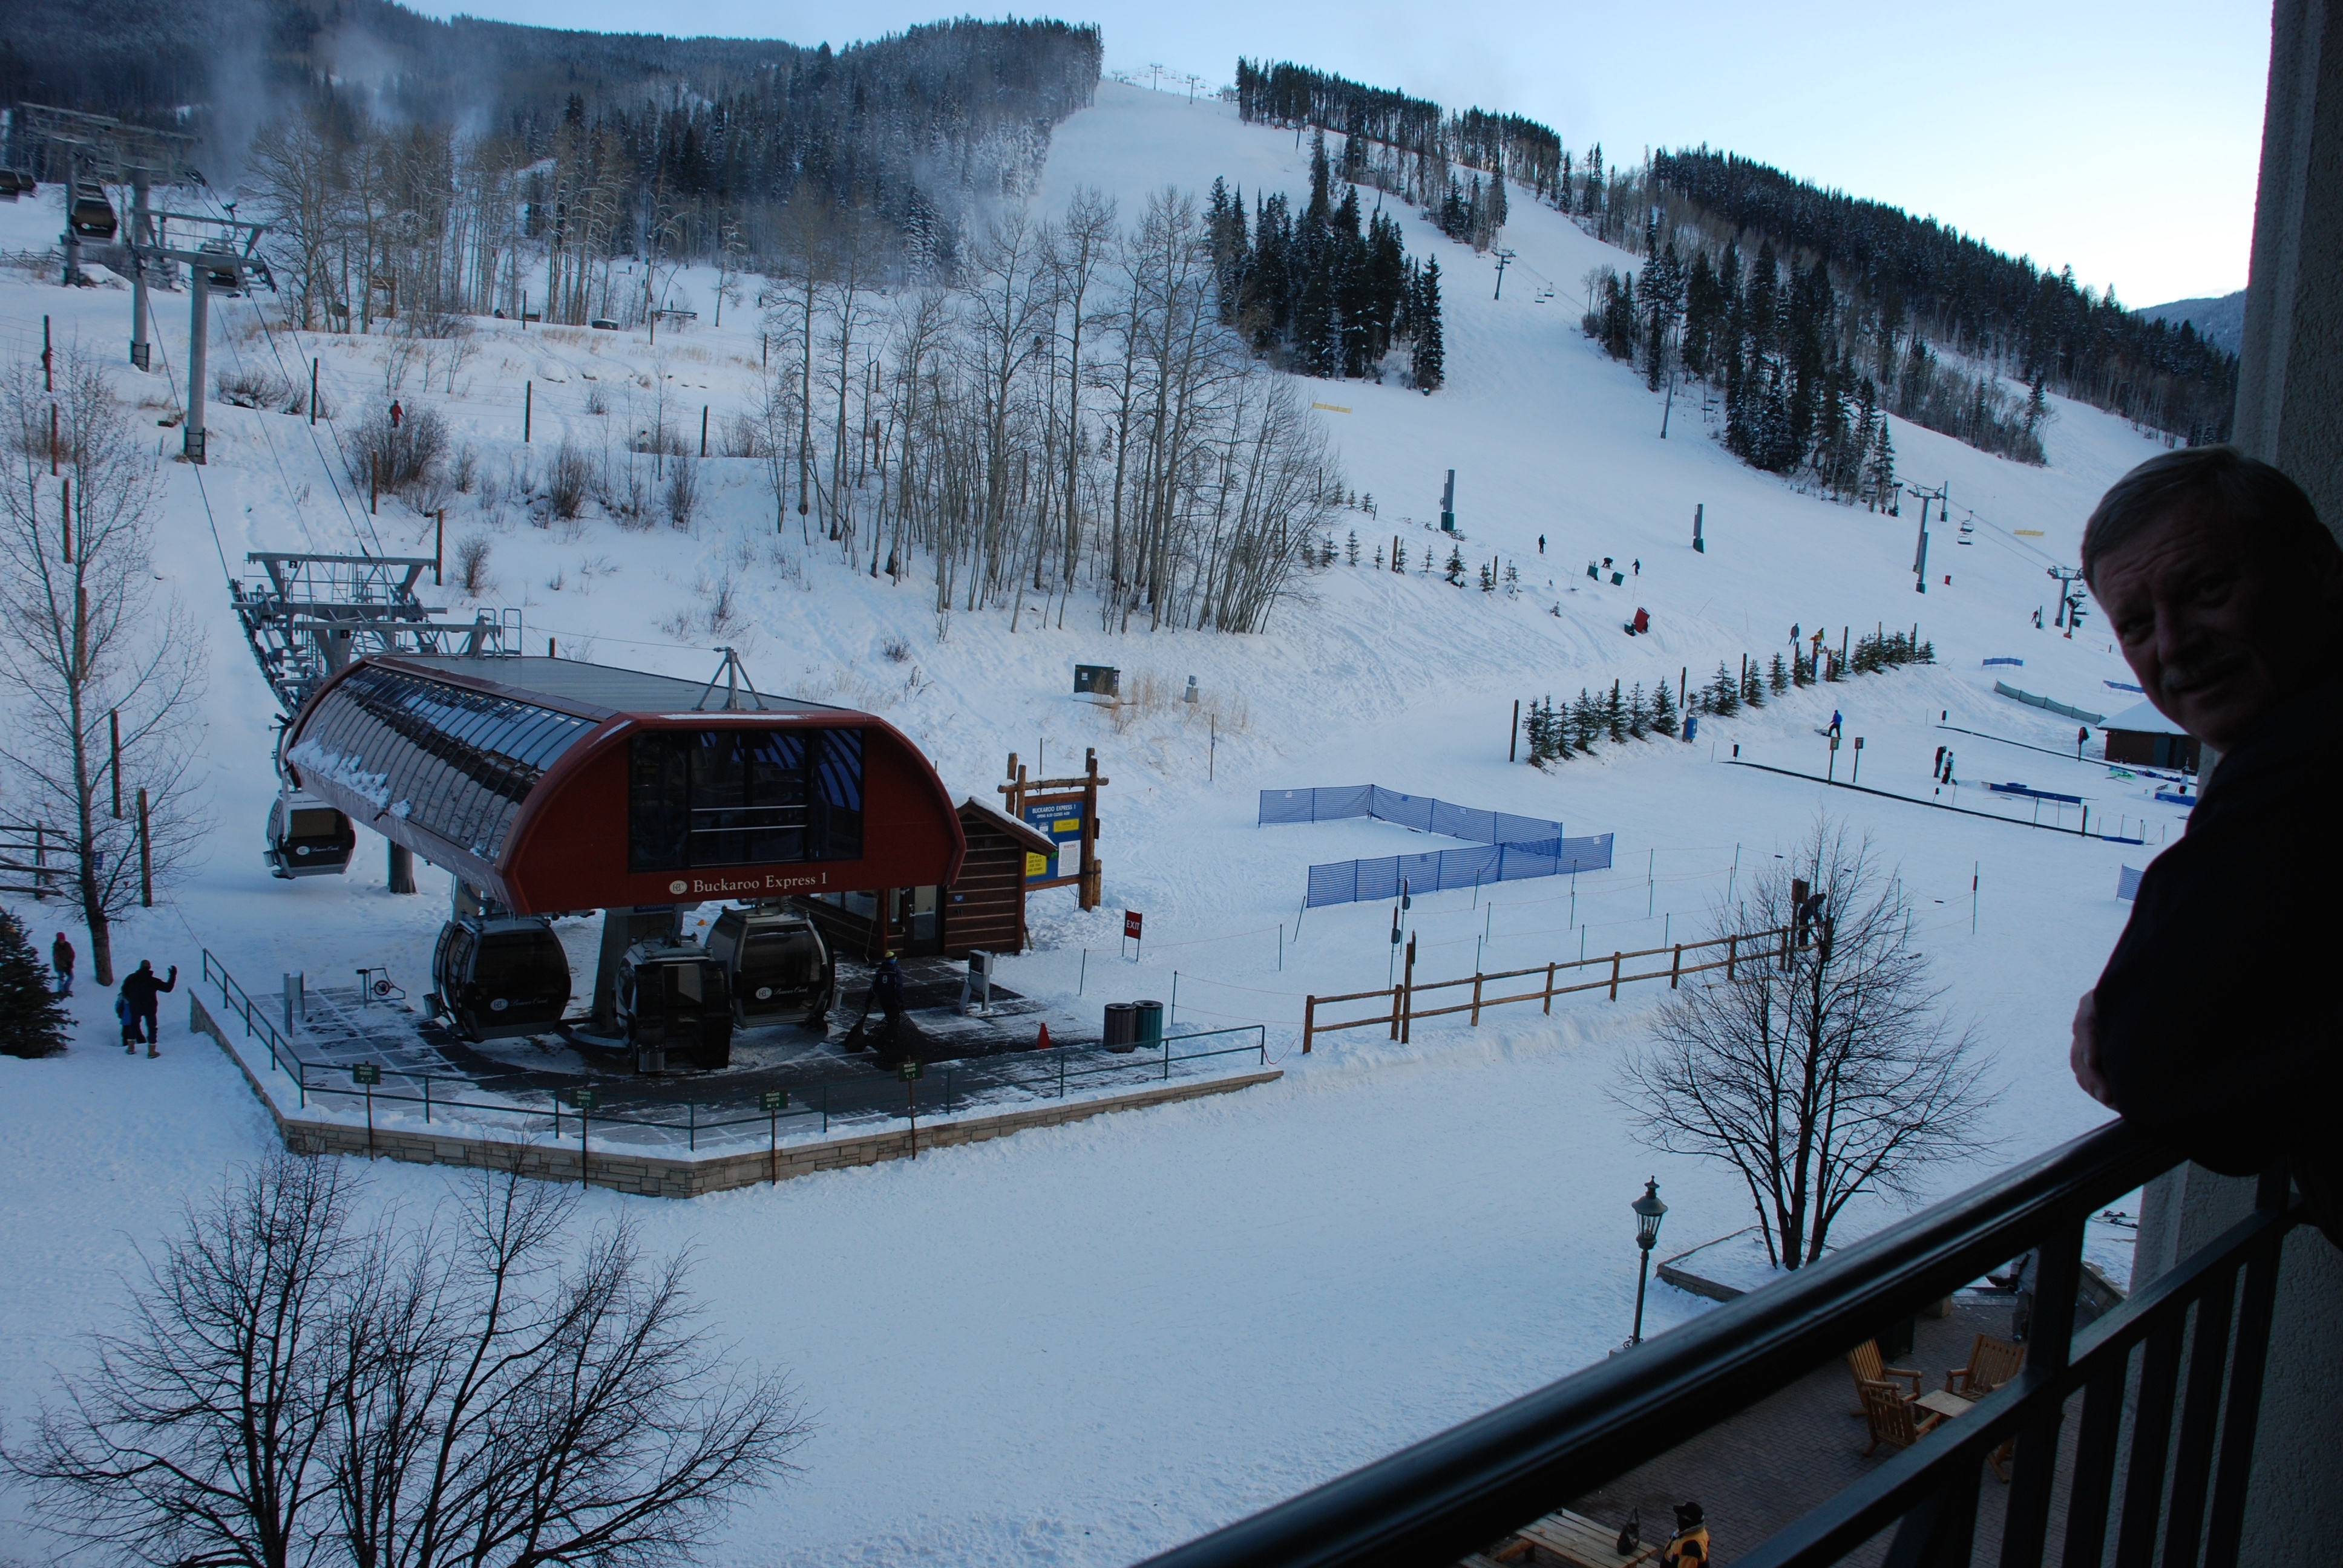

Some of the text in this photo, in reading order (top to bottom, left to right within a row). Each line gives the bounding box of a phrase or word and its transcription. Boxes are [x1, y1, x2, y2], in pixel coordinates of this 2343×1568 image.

[693, 878, 759, 893] Buckaroo
[765, 875, 816, 889] Express
[822, 872, 827, 884] 1
[1126, 920, 1140, 930] EXIT
